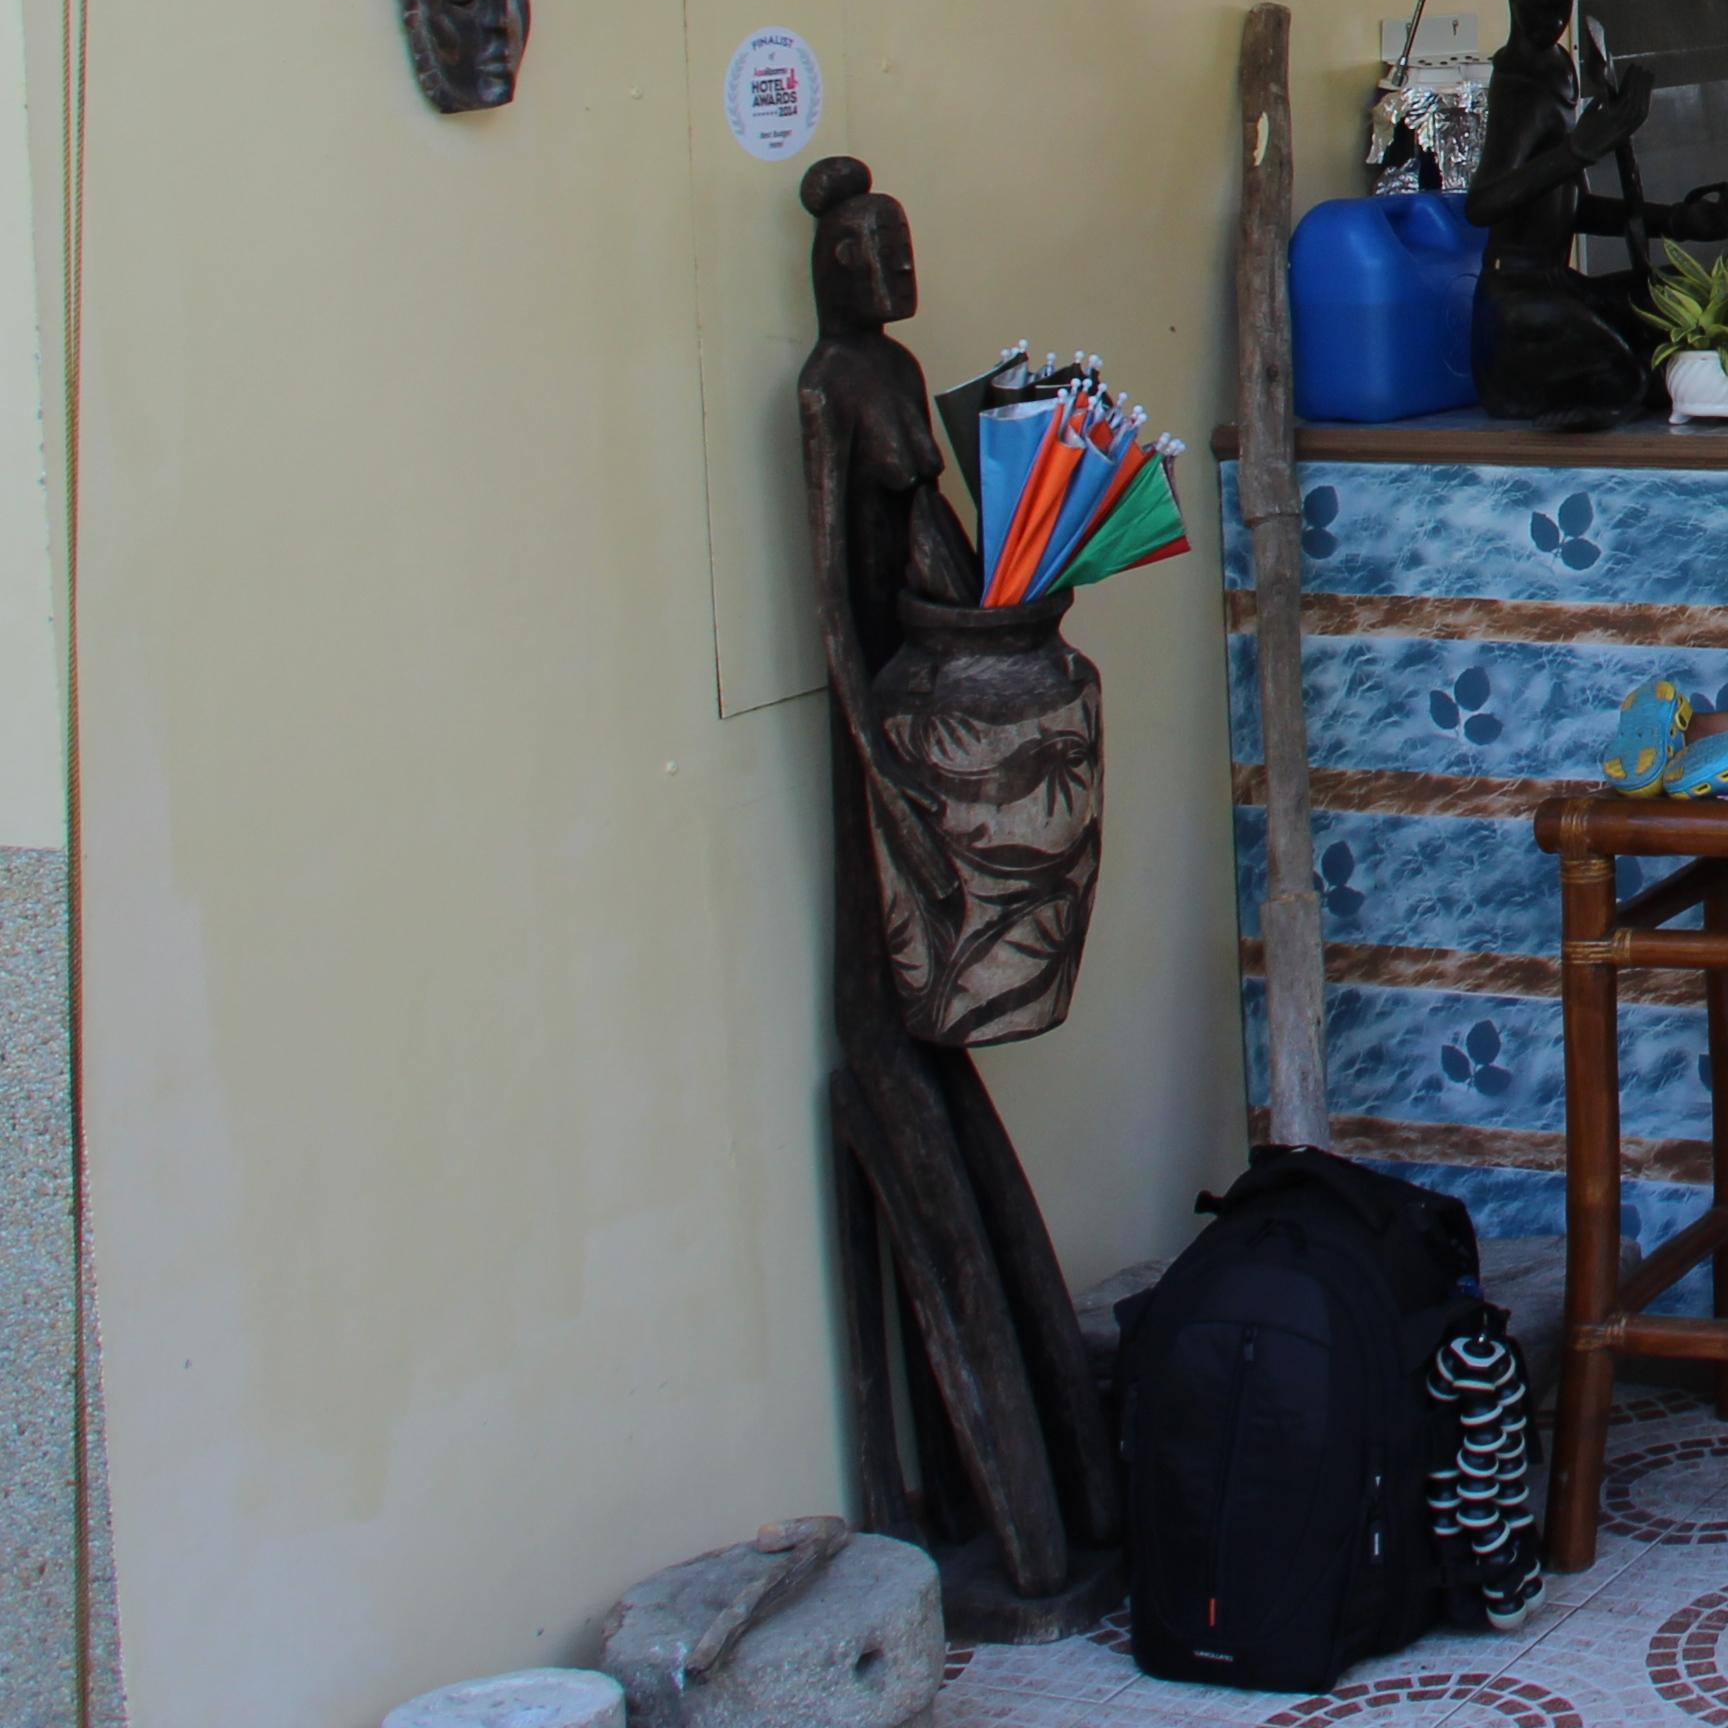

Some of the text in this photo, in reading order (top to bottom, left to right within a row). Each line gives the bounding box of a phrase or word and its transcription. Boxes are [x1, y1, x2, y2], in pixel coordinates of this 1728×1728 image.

[752, 36, 794, 51] FINALIST
[752, 79, 785, 93] HOTEL
[753, 91, 798, 107] AWARDS
[778, 106, 798, 117] 2014
